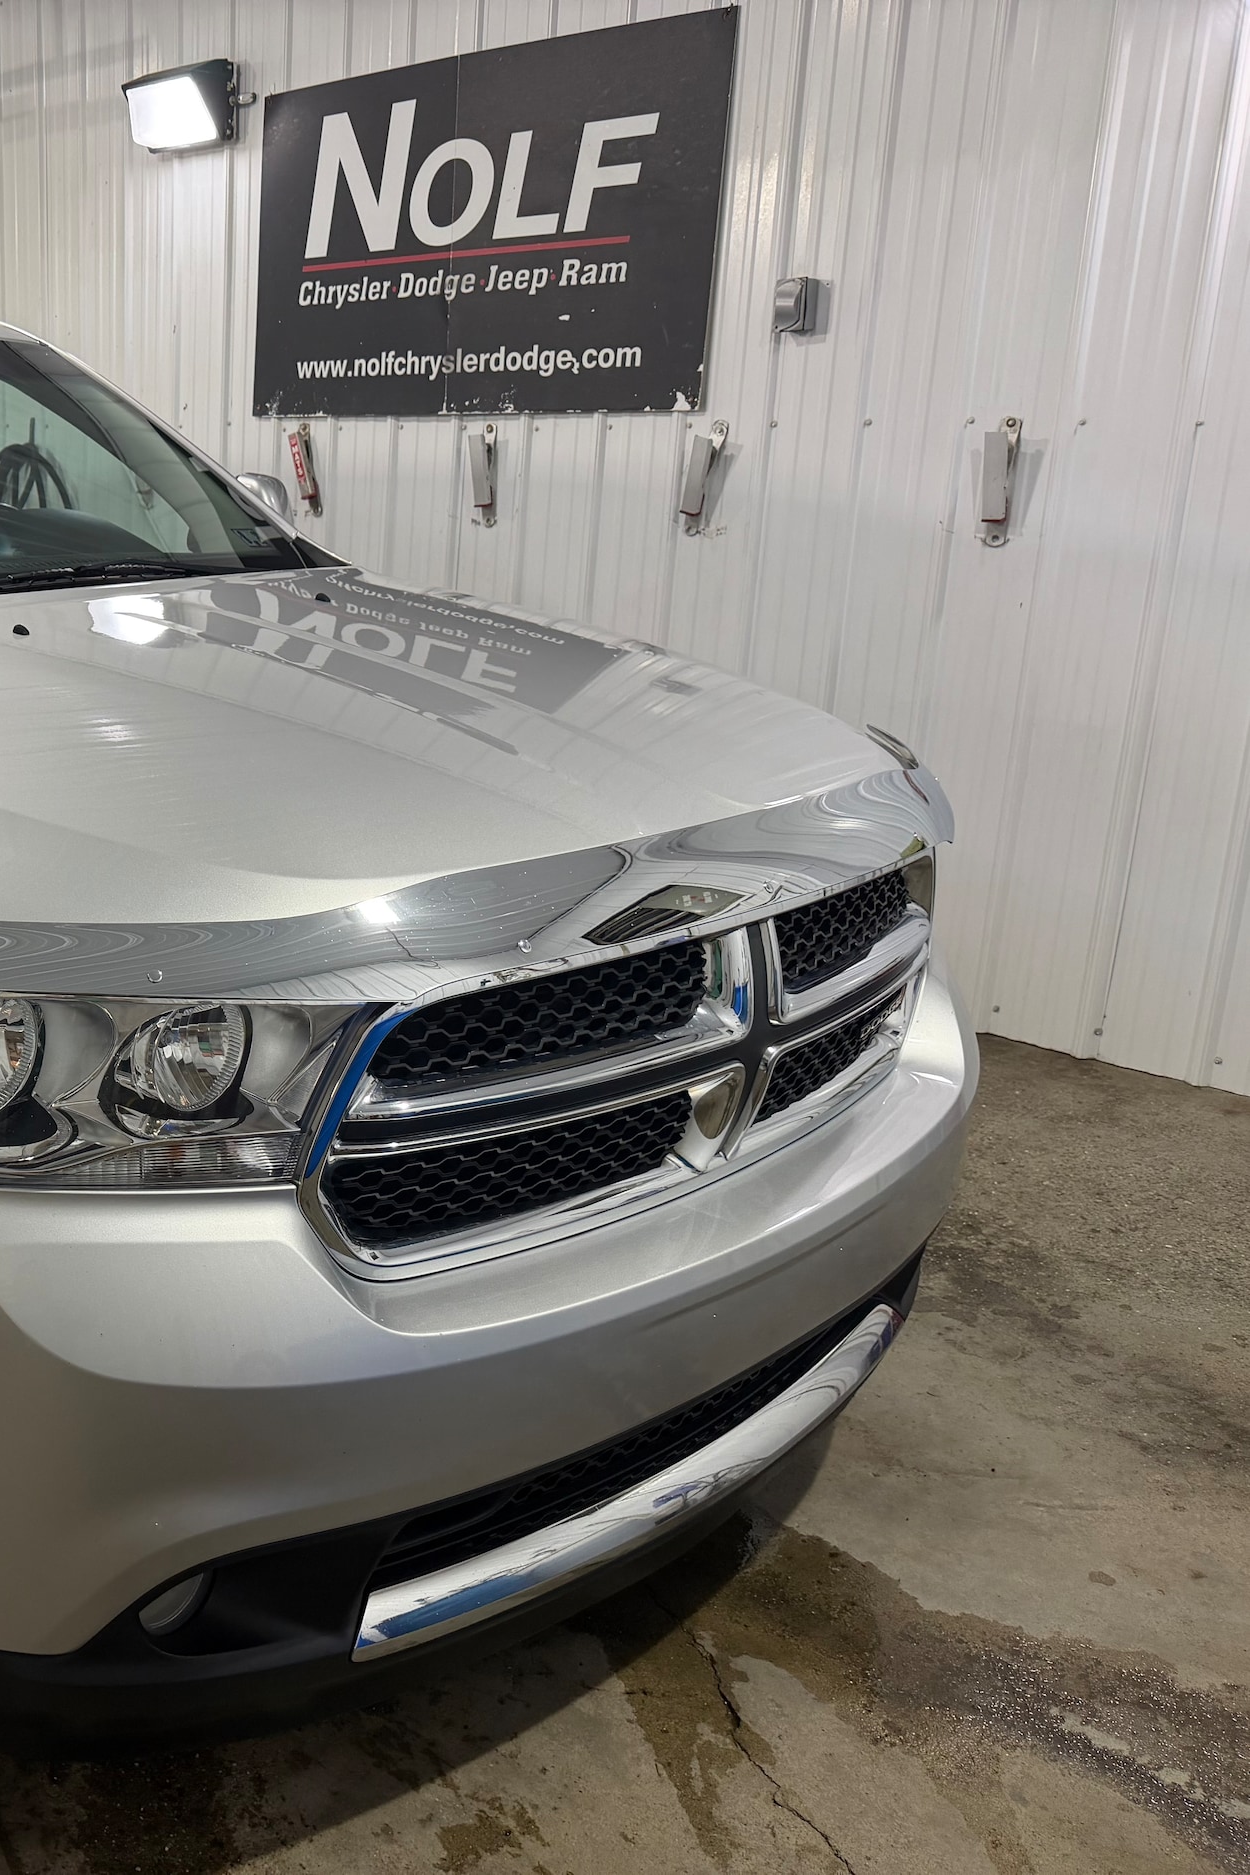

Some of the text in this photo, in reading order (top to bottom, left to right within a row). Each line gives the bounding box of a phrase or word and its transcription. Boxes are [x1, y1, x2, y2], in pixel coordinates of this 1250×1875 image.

[304, 99, 660, 259] NOLF
[298, 258, 628, 309] Chrysler Dodge Jeep Ram
[296, 345, 642, 380] www.nolfchryslerdodge.com
